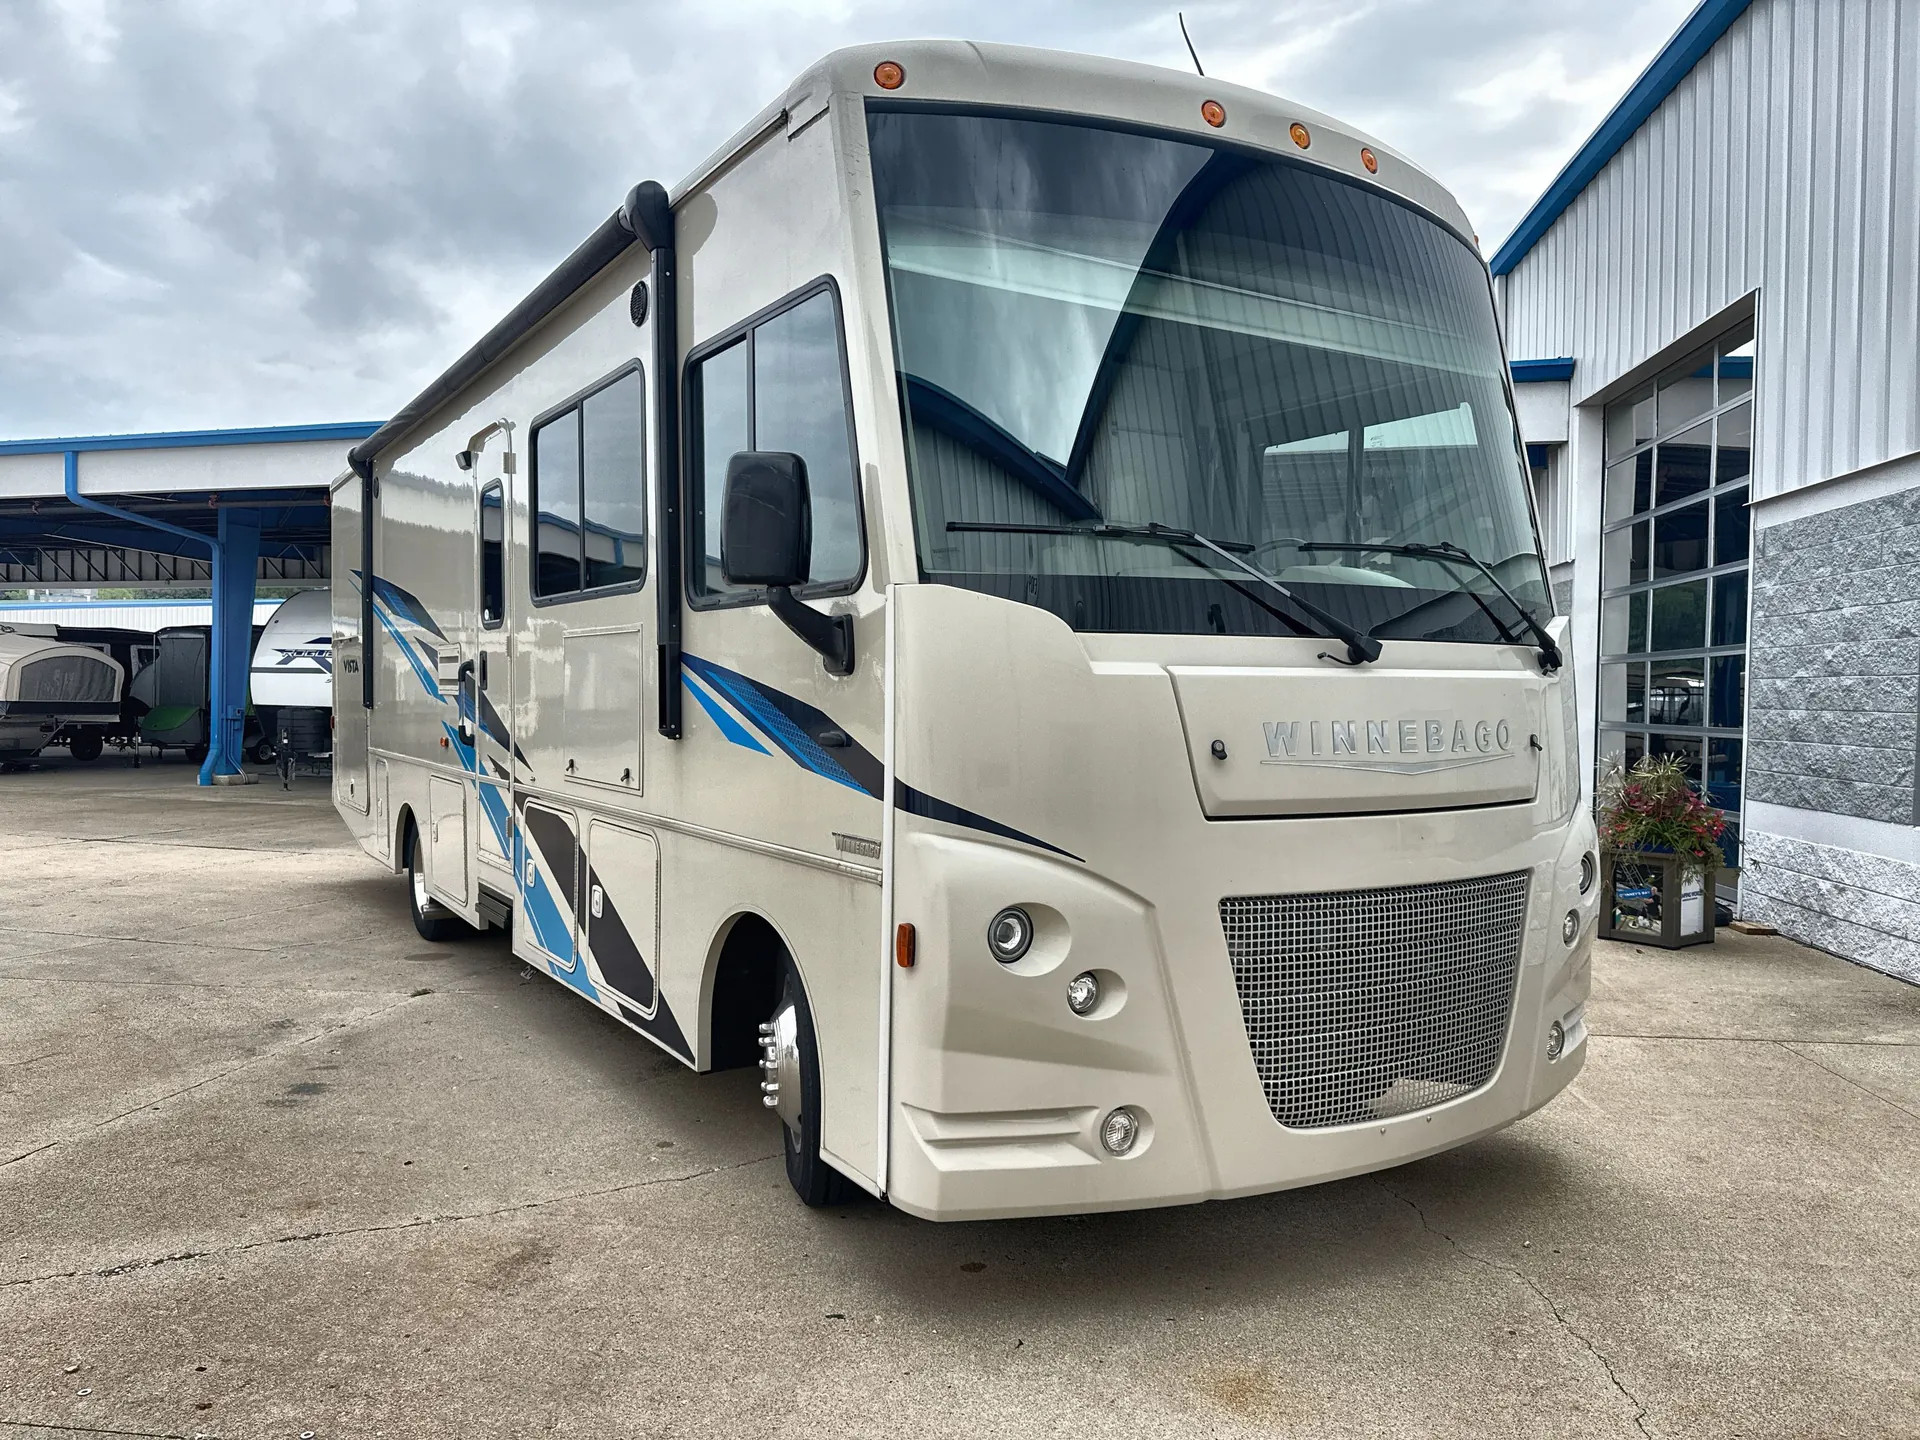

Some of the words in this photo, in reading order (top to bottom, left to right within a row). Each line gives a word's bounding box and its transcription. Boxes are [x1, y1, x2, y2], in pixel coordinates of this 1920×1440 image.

[343, 659, 359, 673] VISTA
[1263, 719, 1512, 757] WINNEBAGO
[833, 832, 881, 860] WINNEBAGO
